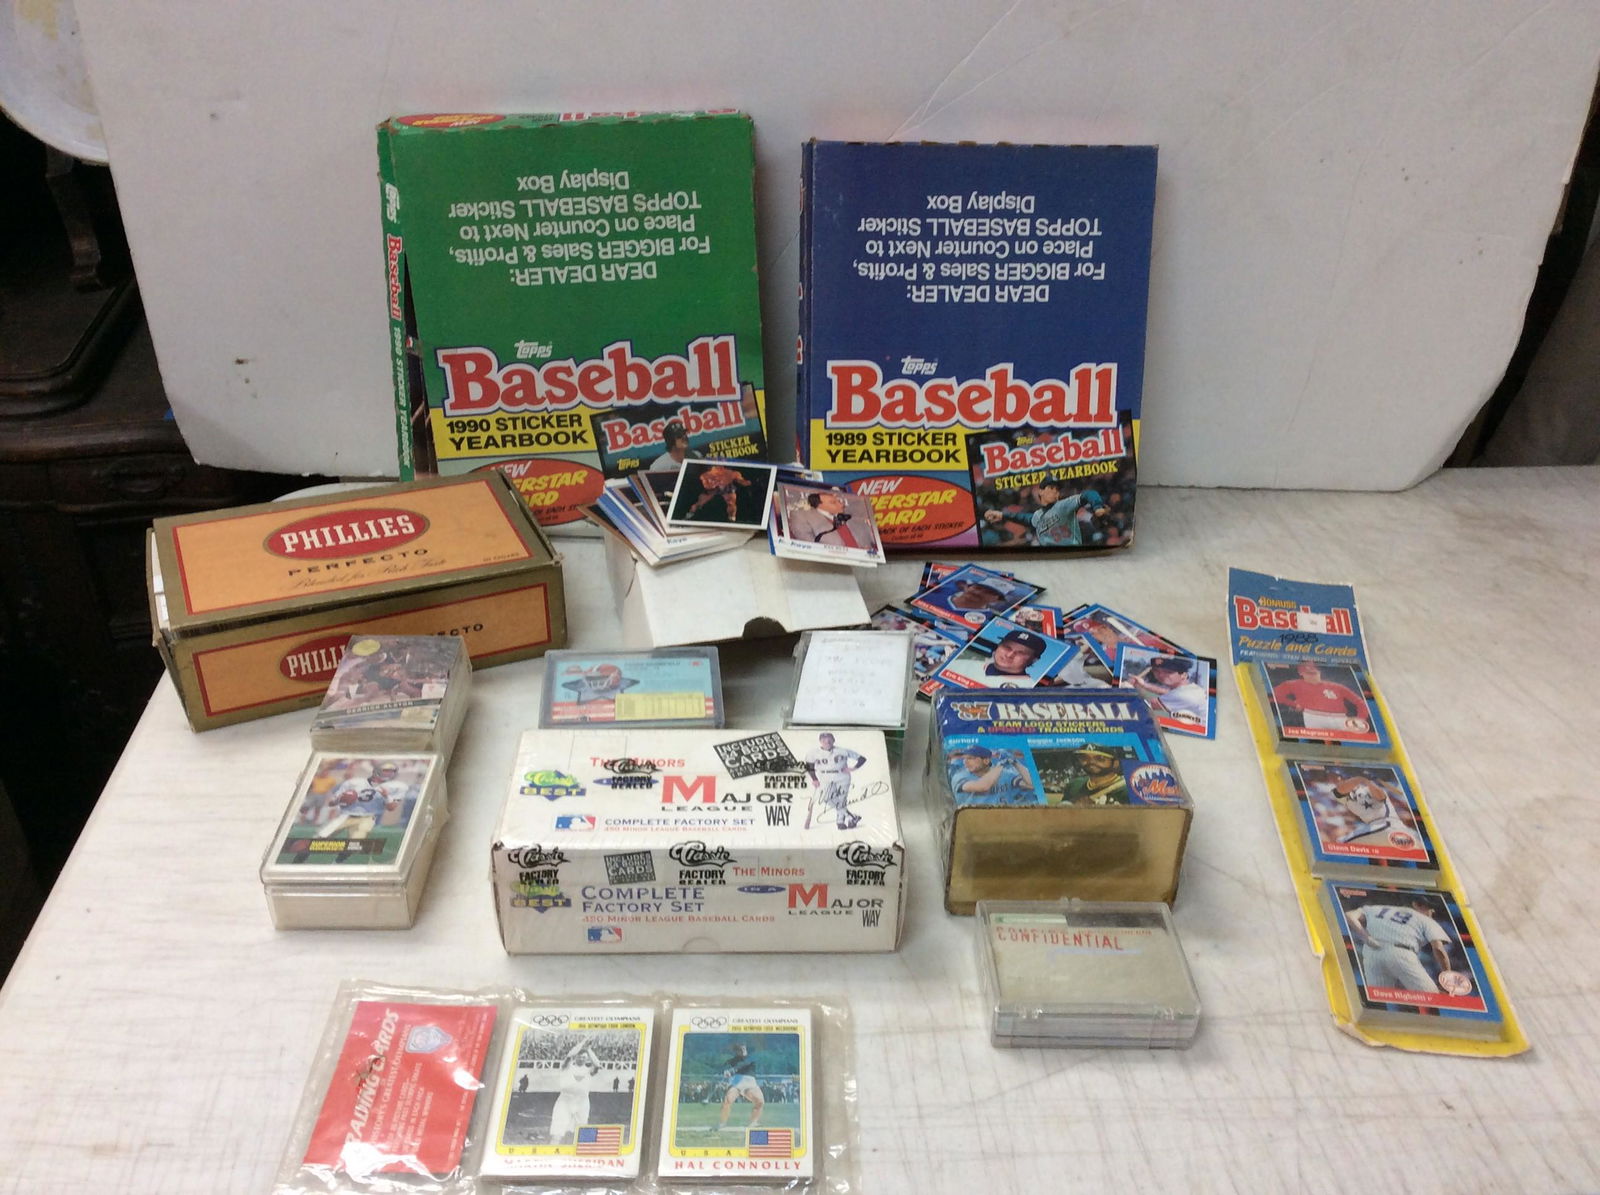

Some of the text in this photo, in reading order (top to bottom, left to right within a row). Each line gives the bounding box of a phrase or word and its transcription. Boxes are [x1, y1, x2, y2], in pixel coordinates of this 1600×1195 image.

[518, 170, 630, 192] Display Box
[448, 190, 703, 220] TOPPS BASEBALL Sticker
[926, 192, 1036, 213] Display Box
[459, 214, 696, 240] Place on Counter Next to
[858, 217, 1102, 236] TOPPS BASEBALL Sticker
[449, 236, 711, 265] For BIGGER Sales & Profits,
[866, 240, 1094, 258] Place on Counter Next to
[387, 234, 402, 321] Baseball
[510, 260, 657, 286] DEAR DEALER:
[853, 260, 1106, 280] For BIGGER Sales & Profits,
[907, 284, 1050, 302] DEAR DEALER:
[437, 335, 740, 415] Baseball
[827, 360, 1117, 428] Baseball
[446, 414, 582, 434] 1990 STICKER
[450, 430, 589, 451] YEARBOOK
[709, 435, 751, 452] STICKER
[826, 432, 957, 446] 1989 STICKER
[826, 449, 961, 464] YEARBOOK
[981, 429, 1126, 478] Baseball
[495, 460, 532, 476] EW
[1051, 460, 1119, 481] YEARBOOK
[857, 477, 904, 496] NEW
[281, 514, 416, 554] PHILLIES
[288, 548, 430, 577] PERFECTO
[1234, 596, 1354, 636] Baseall
[1239, 636, 1358, 656] Puzzle and Cards
[1280, 633, 1319, 644] 1988
[996, 702, 1138, 720] BASEBALL
[716, 733, 780, 754] INCLUDES
[741, 740, 783, 756] BONUS
[724, 748, 789, 768] CARDS
[661, 775, 794, 804] MAJOR
[766, 805, 791, 827] WAY
[679, 870, 725, 880] FACTORY
[733, 866, 805, 877] THE MINORS
[846, 870, 886, 880] FACTORY
[582, 886, 704, 900] COMPLETE
[788, 884, 884, 908] MAJOR
[582, 902, 704, 913] FACTORY SET
[862, 910, 882, 928] WAY
[996, 927, 1124, 950] CONFIDENTIAL
[344, 1072, 381, 1142] RADING
[675, 1160, 801, 1170] HAL CONNOLLY
